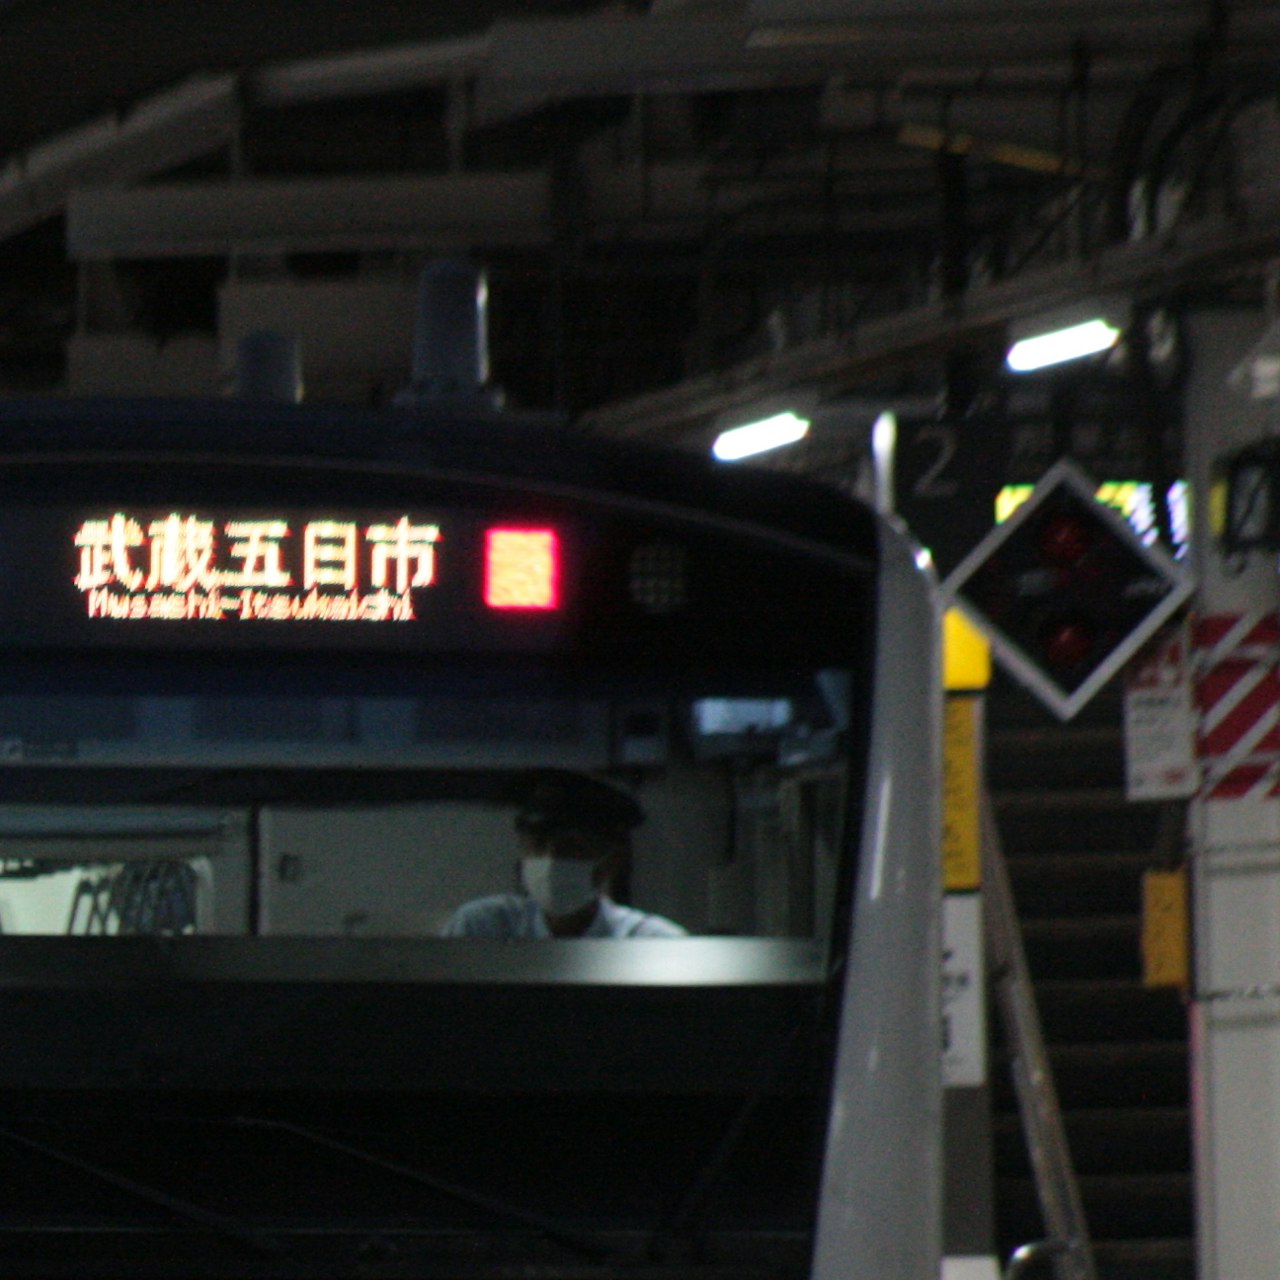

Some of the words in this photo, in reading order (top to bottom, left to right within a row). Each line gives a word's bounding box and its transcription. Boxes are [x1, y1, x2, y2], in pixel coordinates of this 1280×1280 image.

[74, 512, 442, 593] 武蔵五日市
